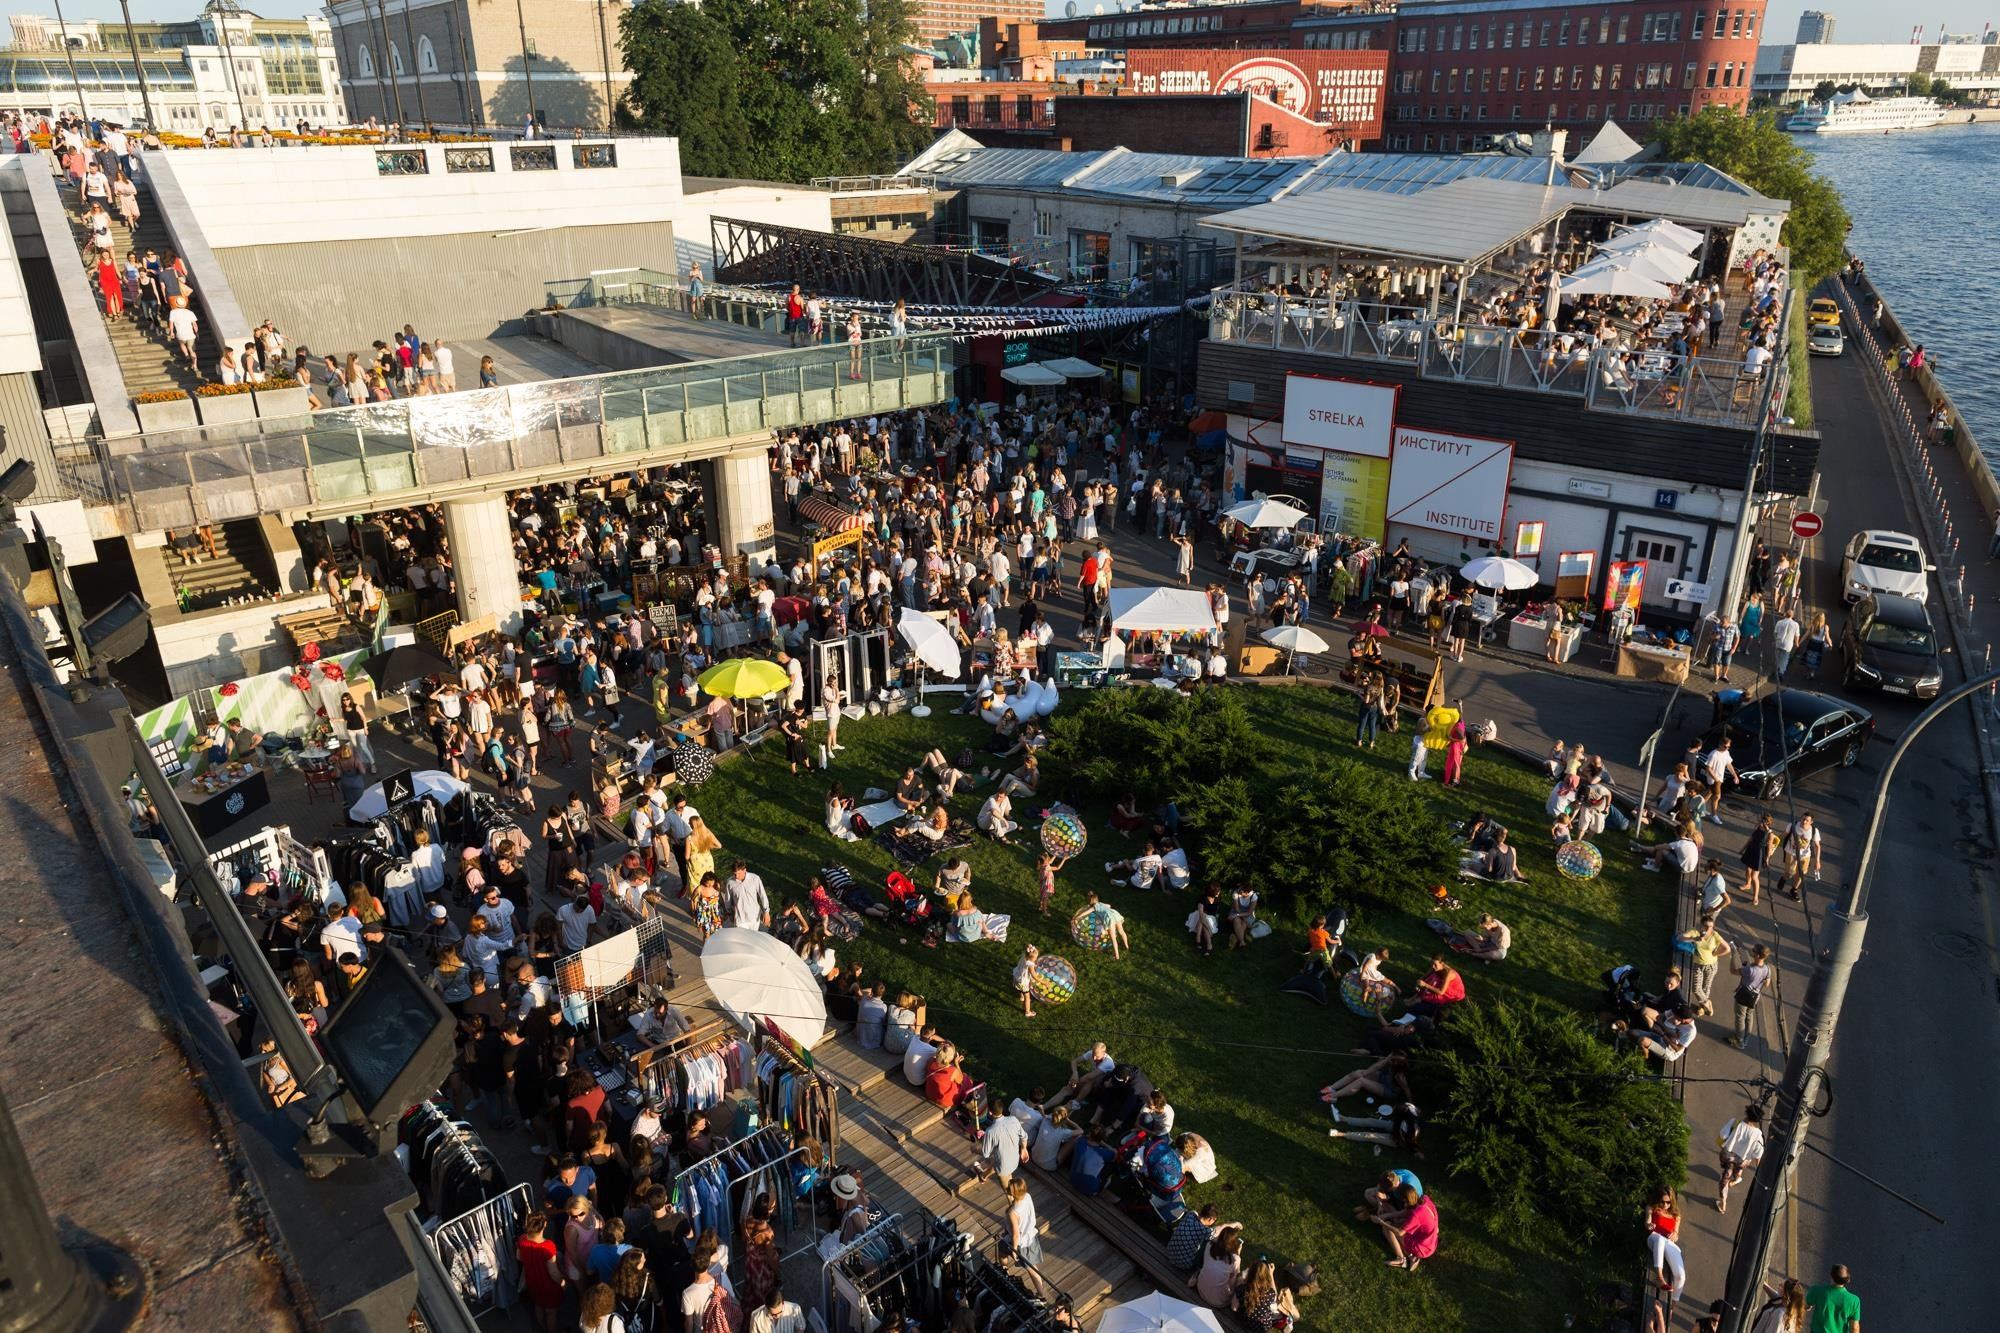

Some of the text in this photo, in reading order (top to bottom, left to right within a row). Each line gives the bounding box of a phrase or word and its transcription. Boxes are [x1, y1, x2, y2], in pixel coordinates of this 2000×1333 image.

[1321, 87, 1378, 105] ТРАДИЦИИ
[1006, 342, 1029, 353] BOOK
[1006, 353, 1026, 362] SHOP
[1308, 409, 1365, 428] STRELKA
[1399, 434, 1473, 457] ИНСТИТУТ
[1659, 493, 1672, 505] 14
[1425, 510, 1495, 534] INSTITUTE
